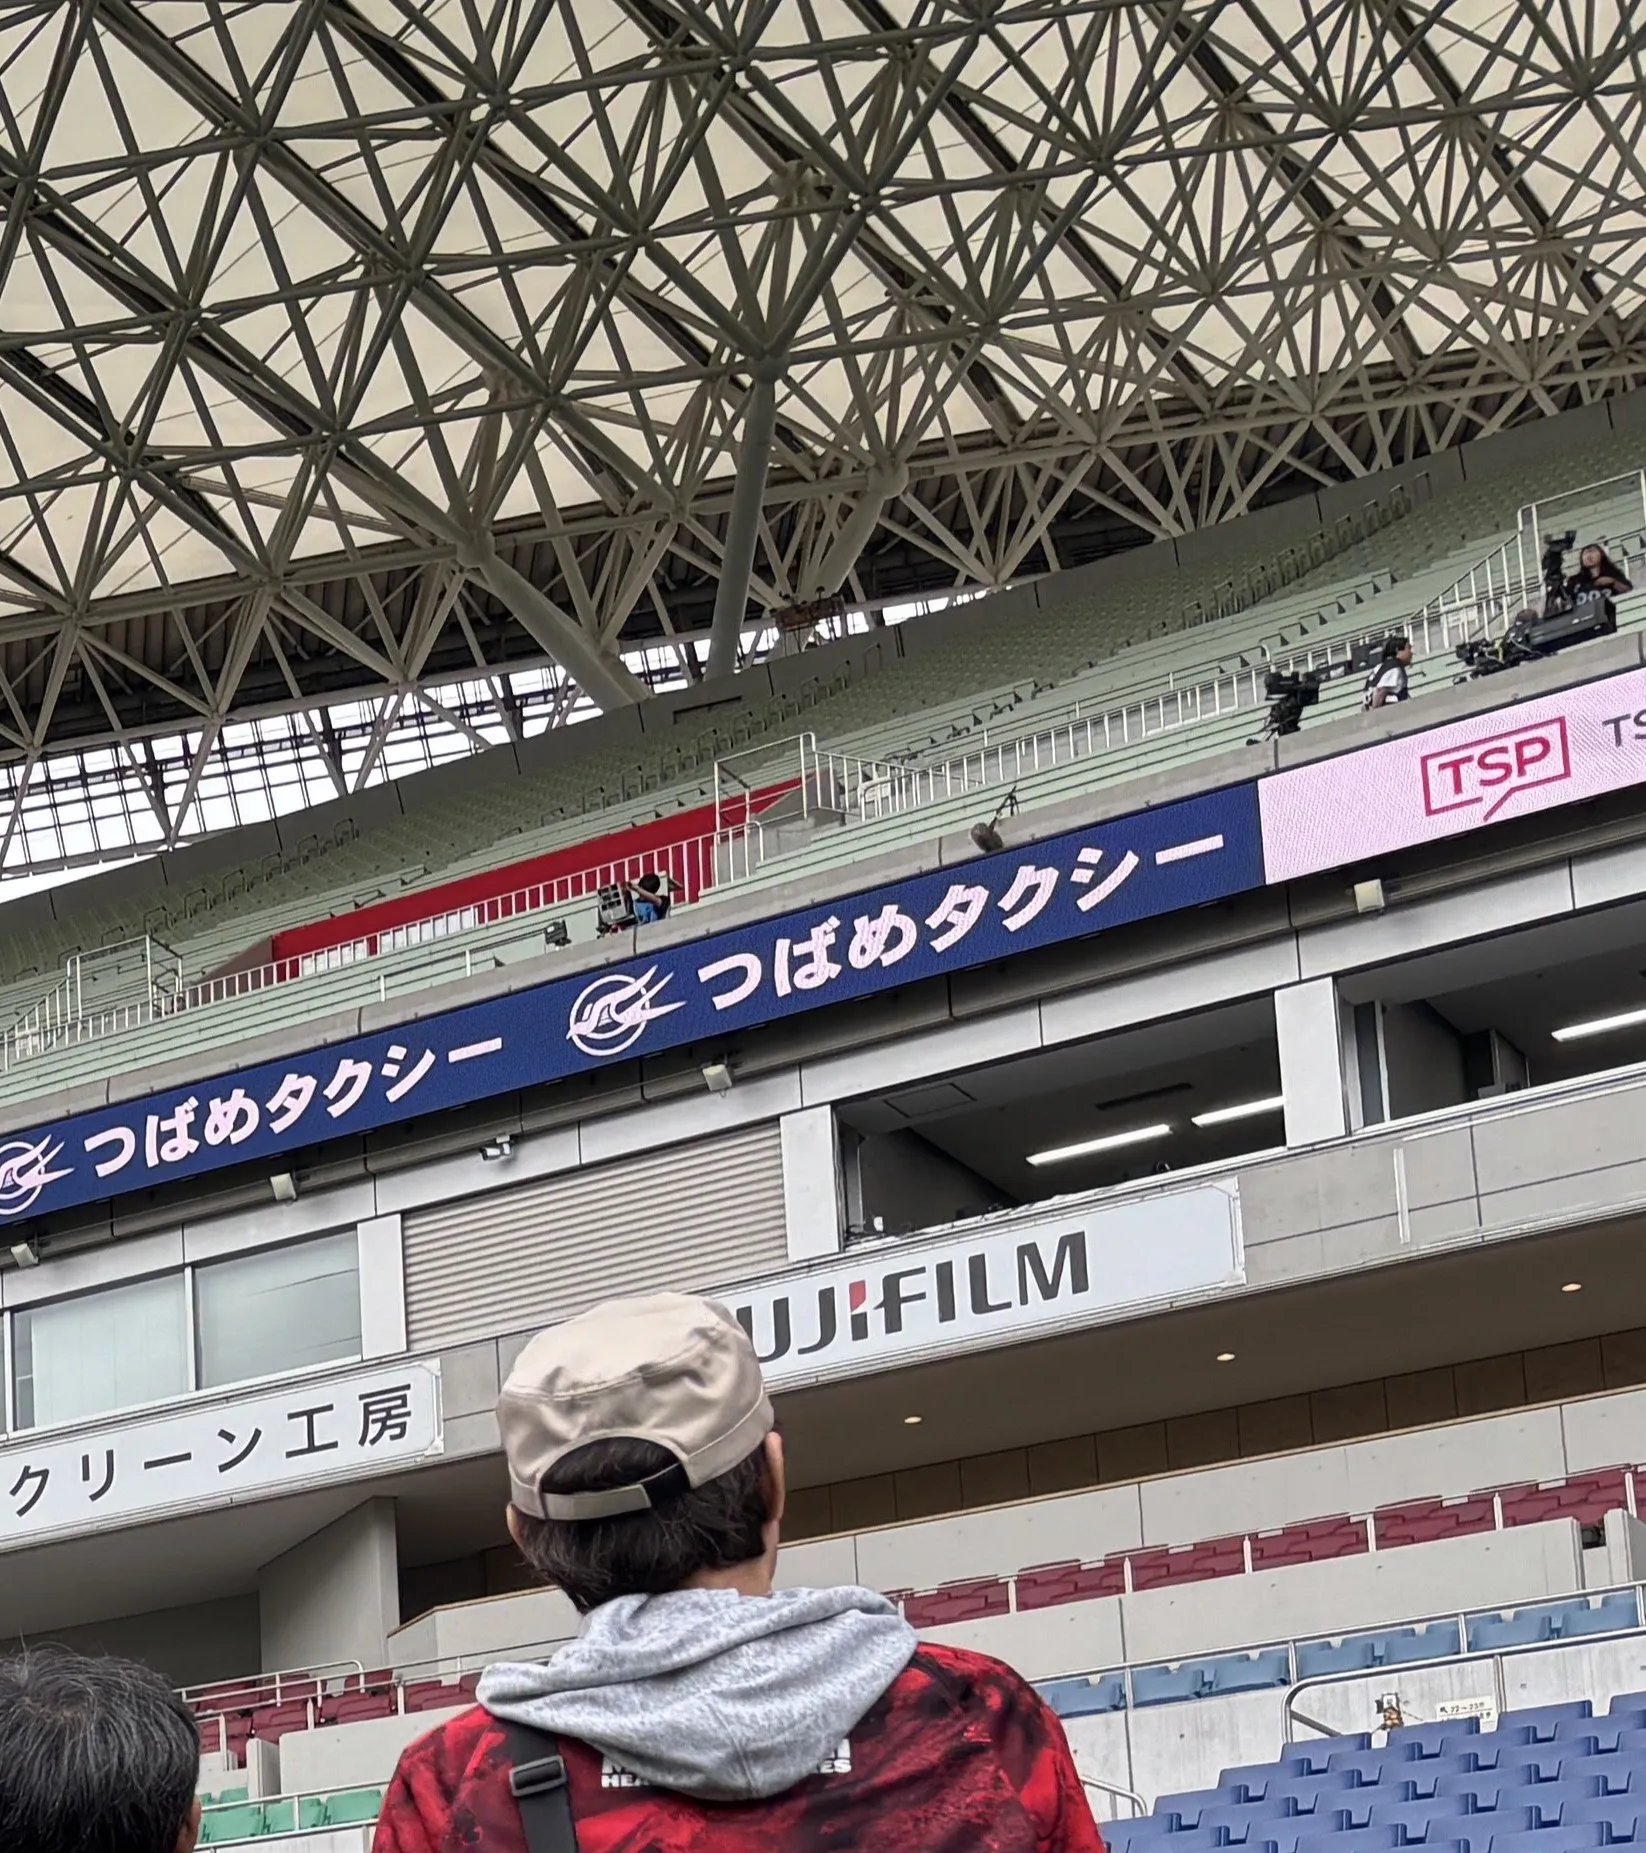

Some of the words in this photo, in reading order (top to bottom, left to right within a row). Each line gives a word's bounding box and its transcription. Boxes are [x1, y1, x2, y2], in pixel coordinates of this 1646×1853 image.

[1438, 737, 1550, 794] TSP
[699, 834, 1223, 1011] つばめタクシー
[85, 1037, 502, 1178] つばめタクシー
[736, 1231, 1089, 1363] UJIFILM
[8, 1383, 411, 1517] クリーン工房
